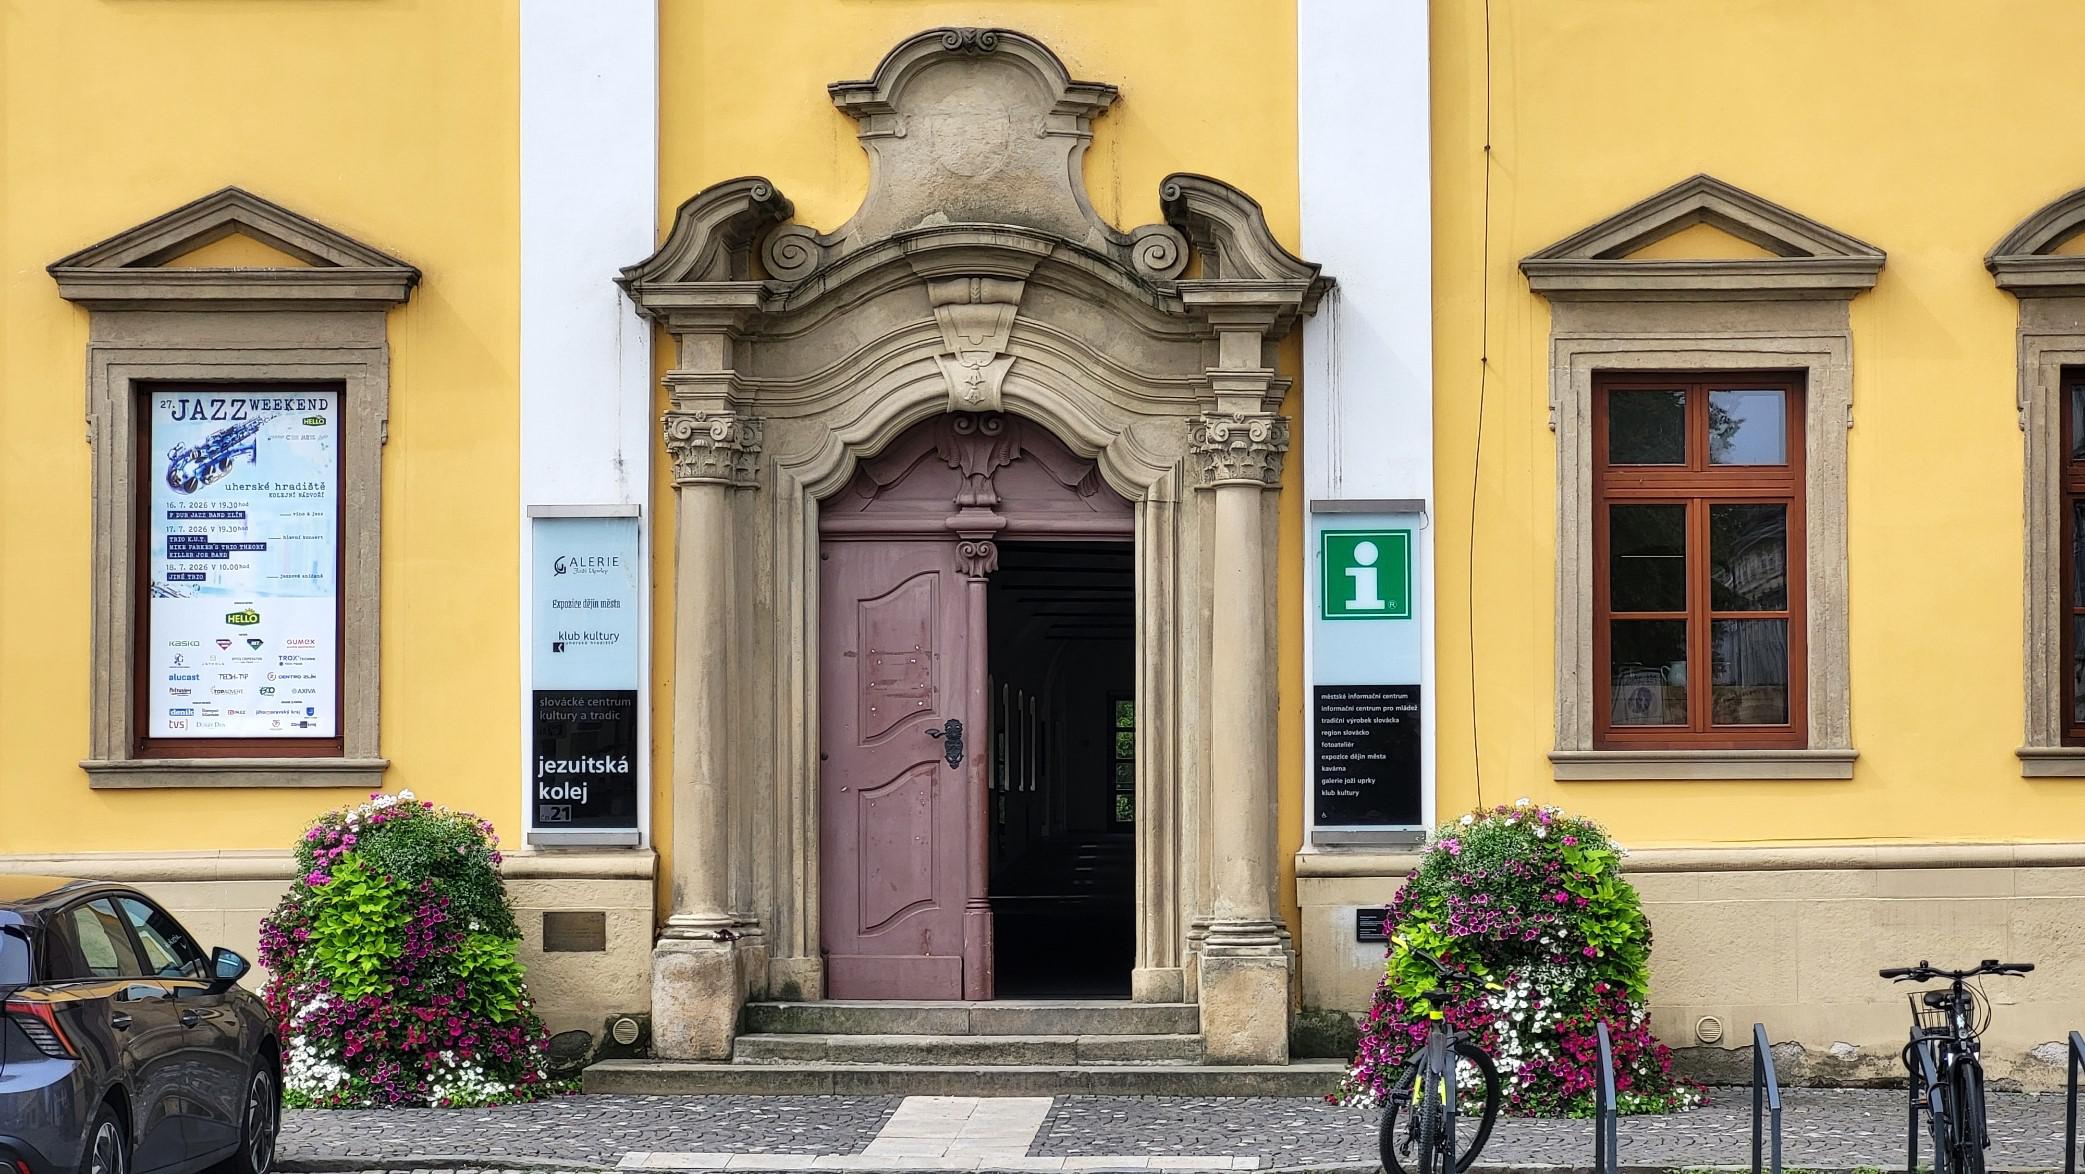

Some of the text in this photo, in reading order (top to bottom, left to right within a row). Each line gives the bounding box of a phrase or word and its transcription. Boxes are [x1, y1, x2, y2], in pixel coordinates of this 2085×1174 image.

[160, 399, 328, 421] 27. JAZZ WEEKEND
[225, 482, 326, 491] uherské hradiště
[552, 598, 620, 610] Expozice dějin města
[228, 614, 257, 623] HELLO
[558, 631, 619, 642] klub kultury
[539, 697, 631, 707] slovácké centrum
[539, 711, 577, 722] kultury
[590, 711, 620, 720] tradic
[538, 755, 629, 778] jezuitská
[539, 782, 588, 804] kolej
